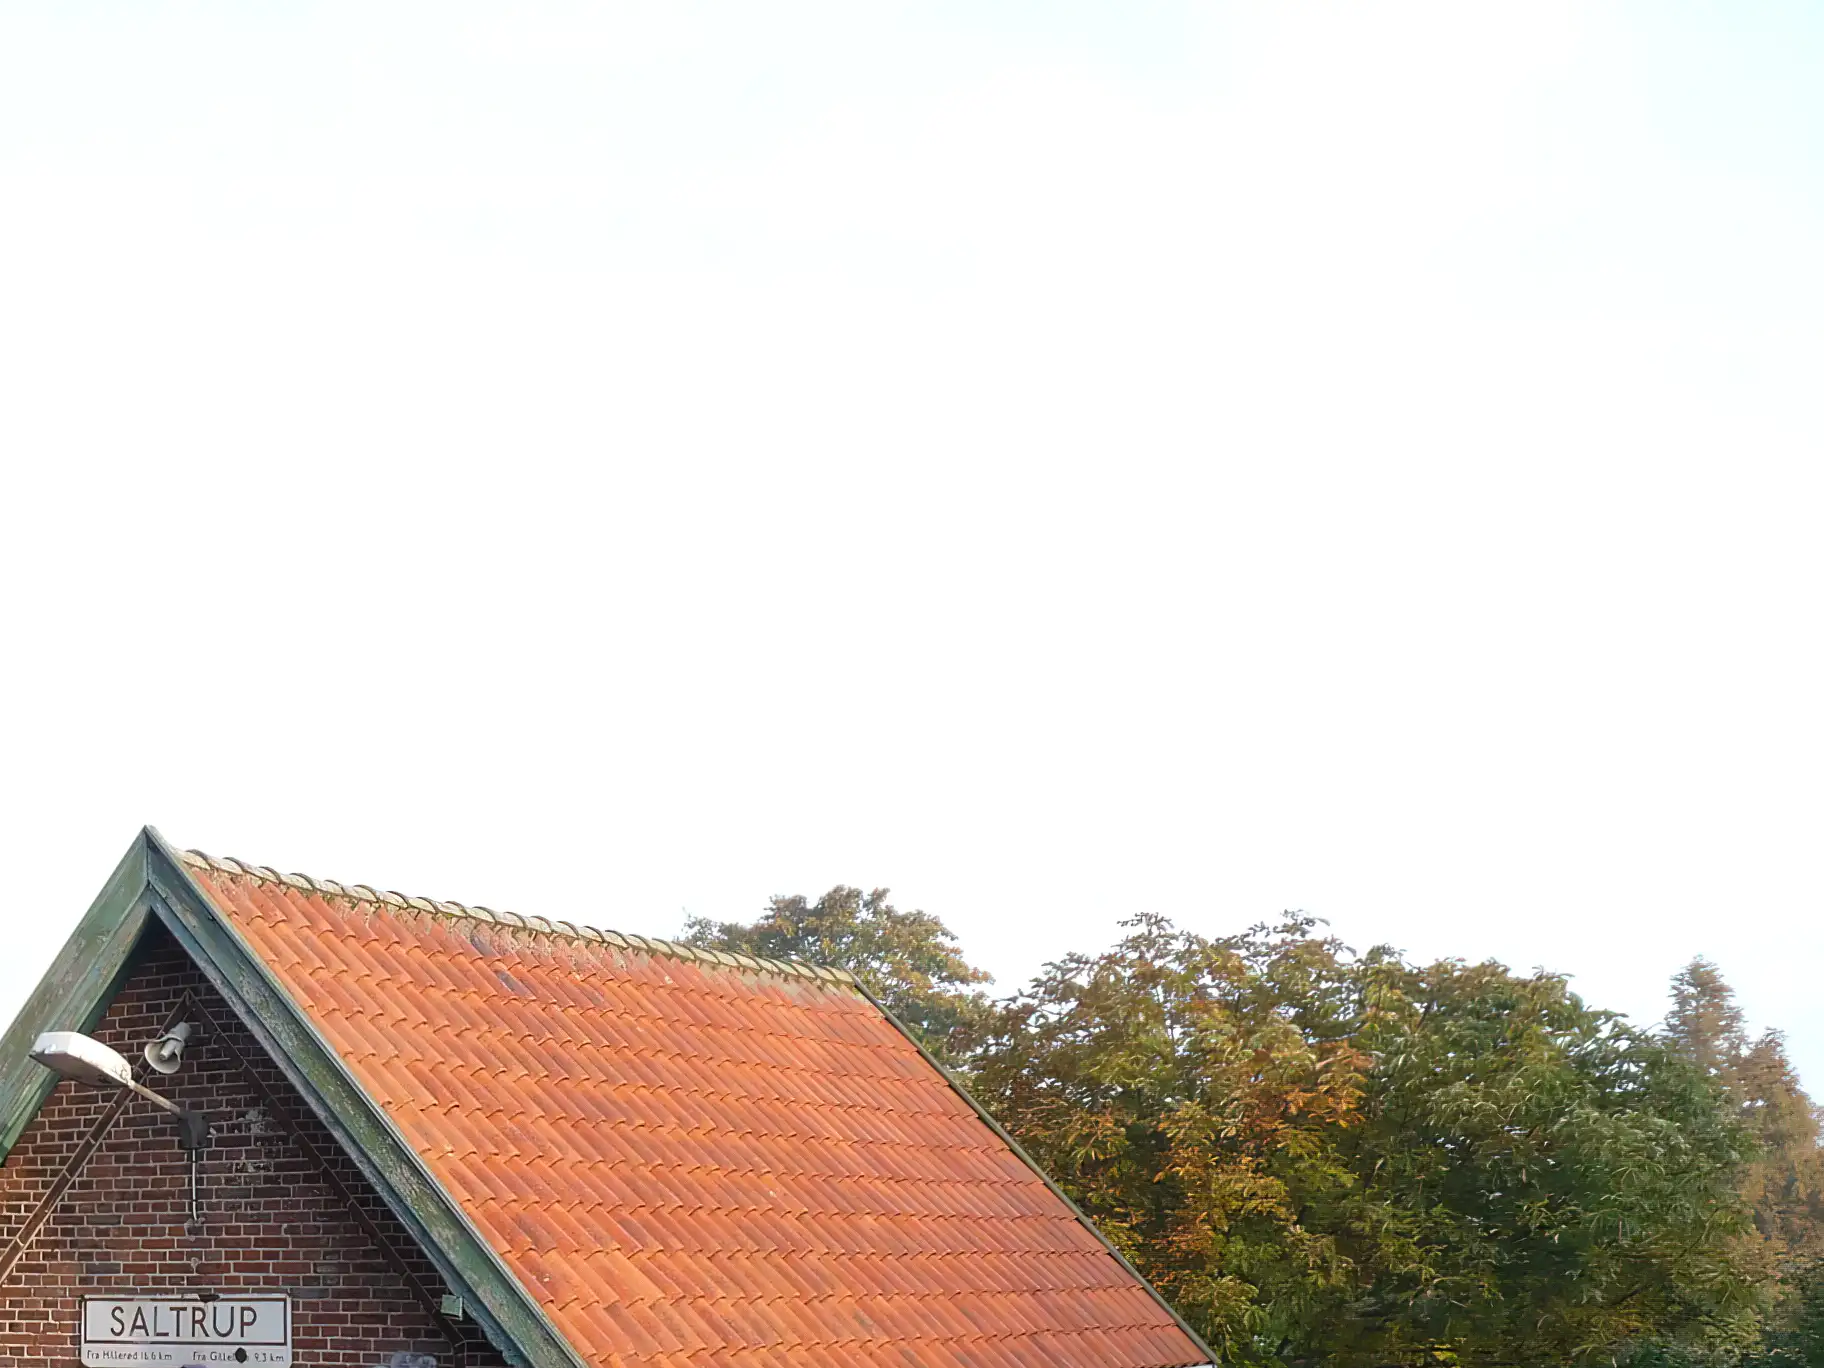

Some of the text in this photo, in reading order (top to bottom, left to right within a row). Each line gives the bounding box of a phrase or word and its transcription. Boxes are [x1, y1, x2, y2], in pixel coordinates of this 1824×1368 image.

[109, 1305, 258, 1338] SALTRUP
[86, 1349, 100, 1360] Fra
[158, 1351, 173, 1361] km
[192, 1351, 207, 1361] Fra
[269, 1352, 285, 1362] km
